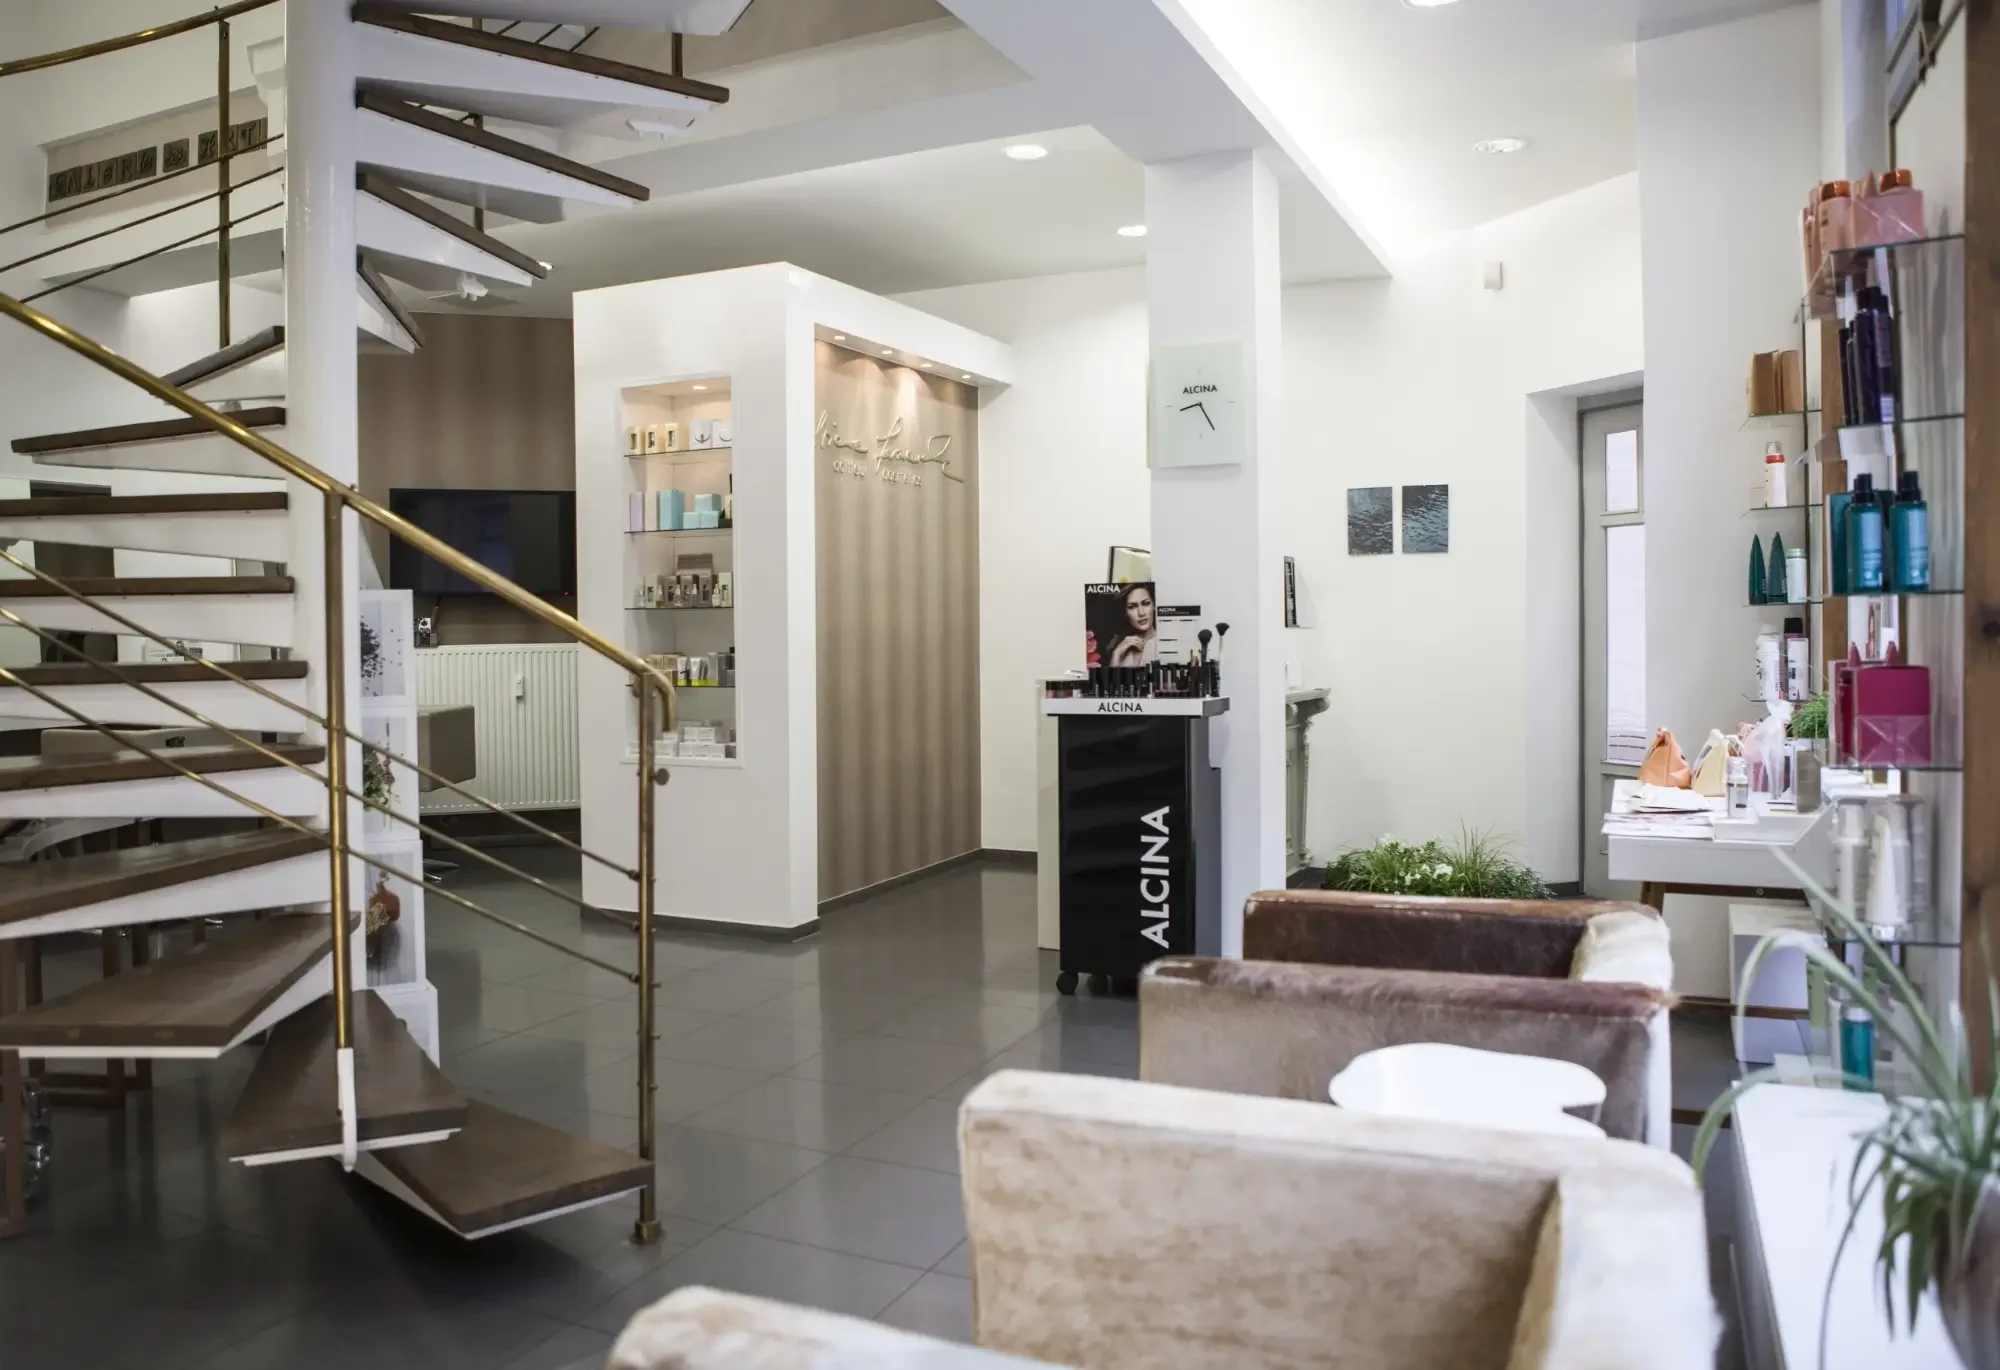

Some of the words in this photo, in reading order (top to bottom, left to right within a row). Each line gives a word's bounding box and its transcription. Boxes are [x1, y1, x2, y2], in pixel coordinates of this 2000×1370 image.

[1182, 384, 1218, 394] ALCINA
[1087, 585, 1120, 593] ALCINA
[1098, 702, 1143, 712] ALCINA
[1140, 805, 1170, 949] ALCINA
